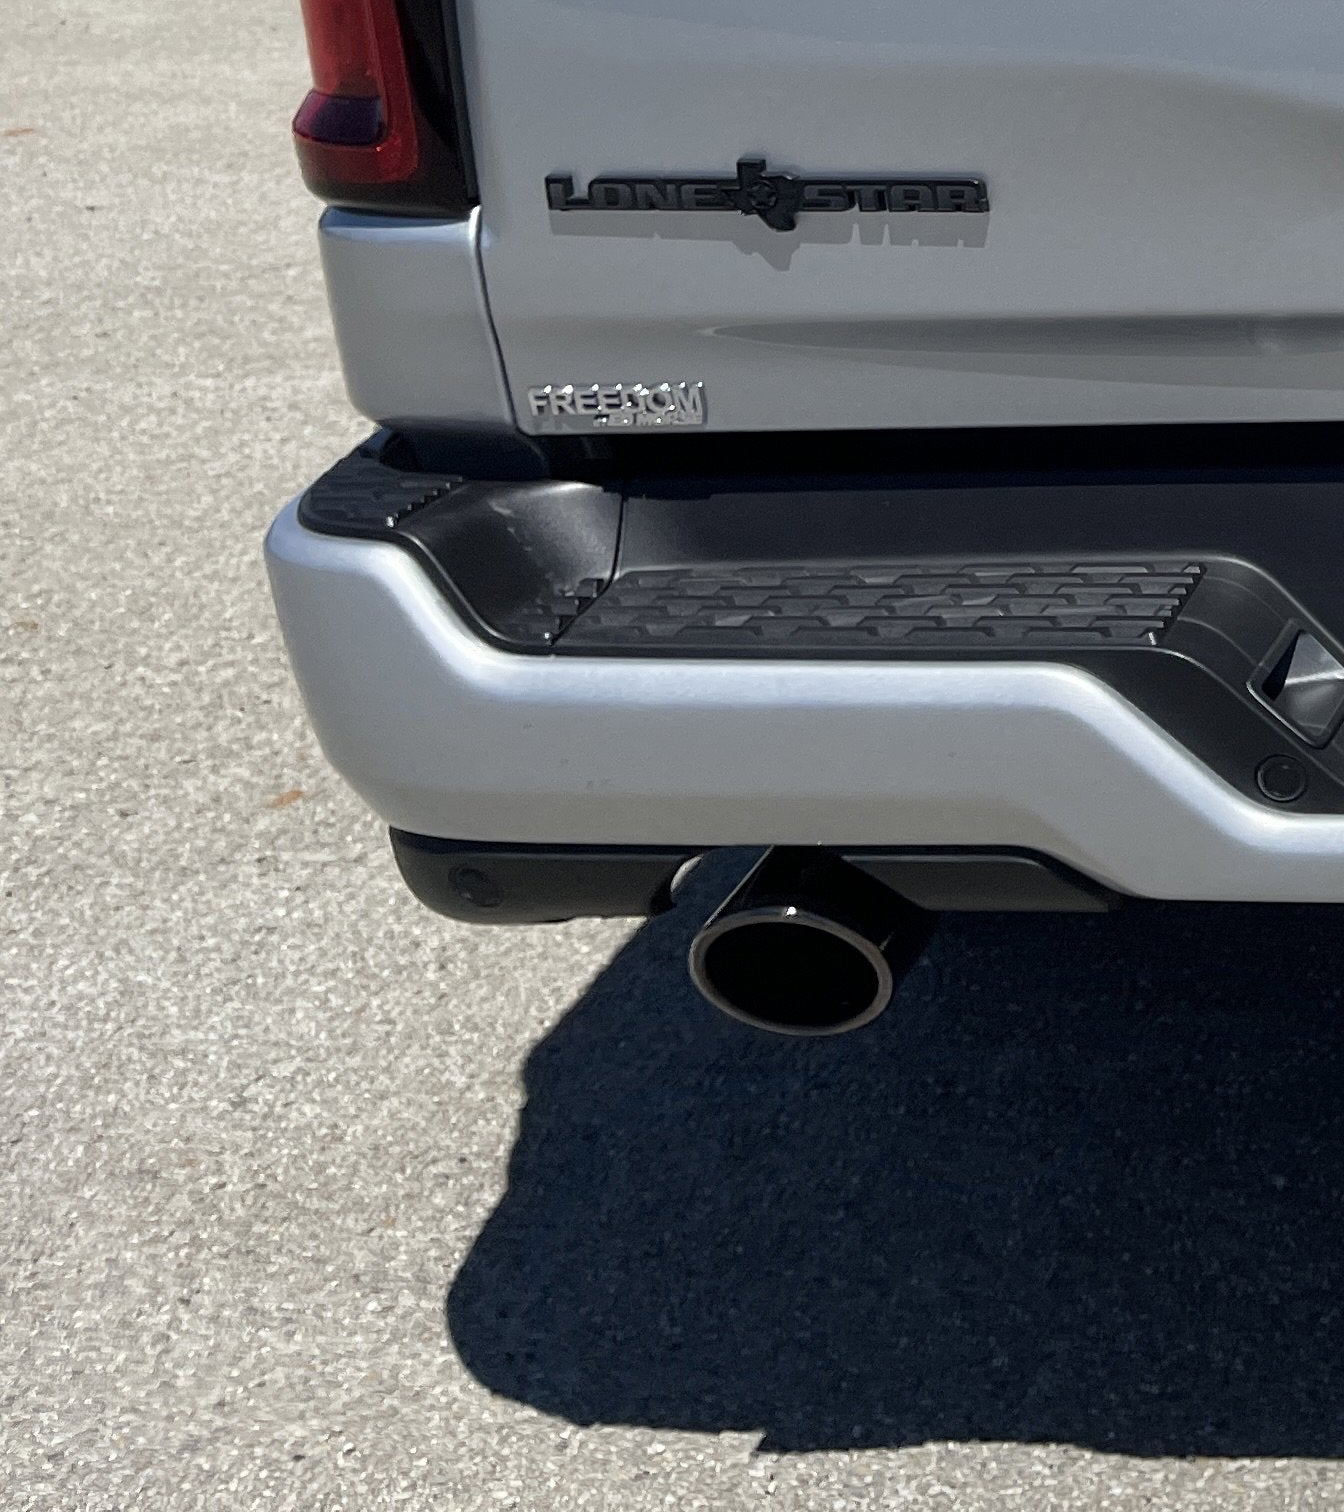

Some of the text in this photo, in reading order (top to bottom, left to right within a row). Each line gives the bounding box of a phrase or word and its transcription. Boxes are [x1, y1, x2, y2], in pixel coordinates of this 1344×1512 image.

[545, 174, 990, 213] LONE STAR
[528, 382, 703, 416] FREEDOM
